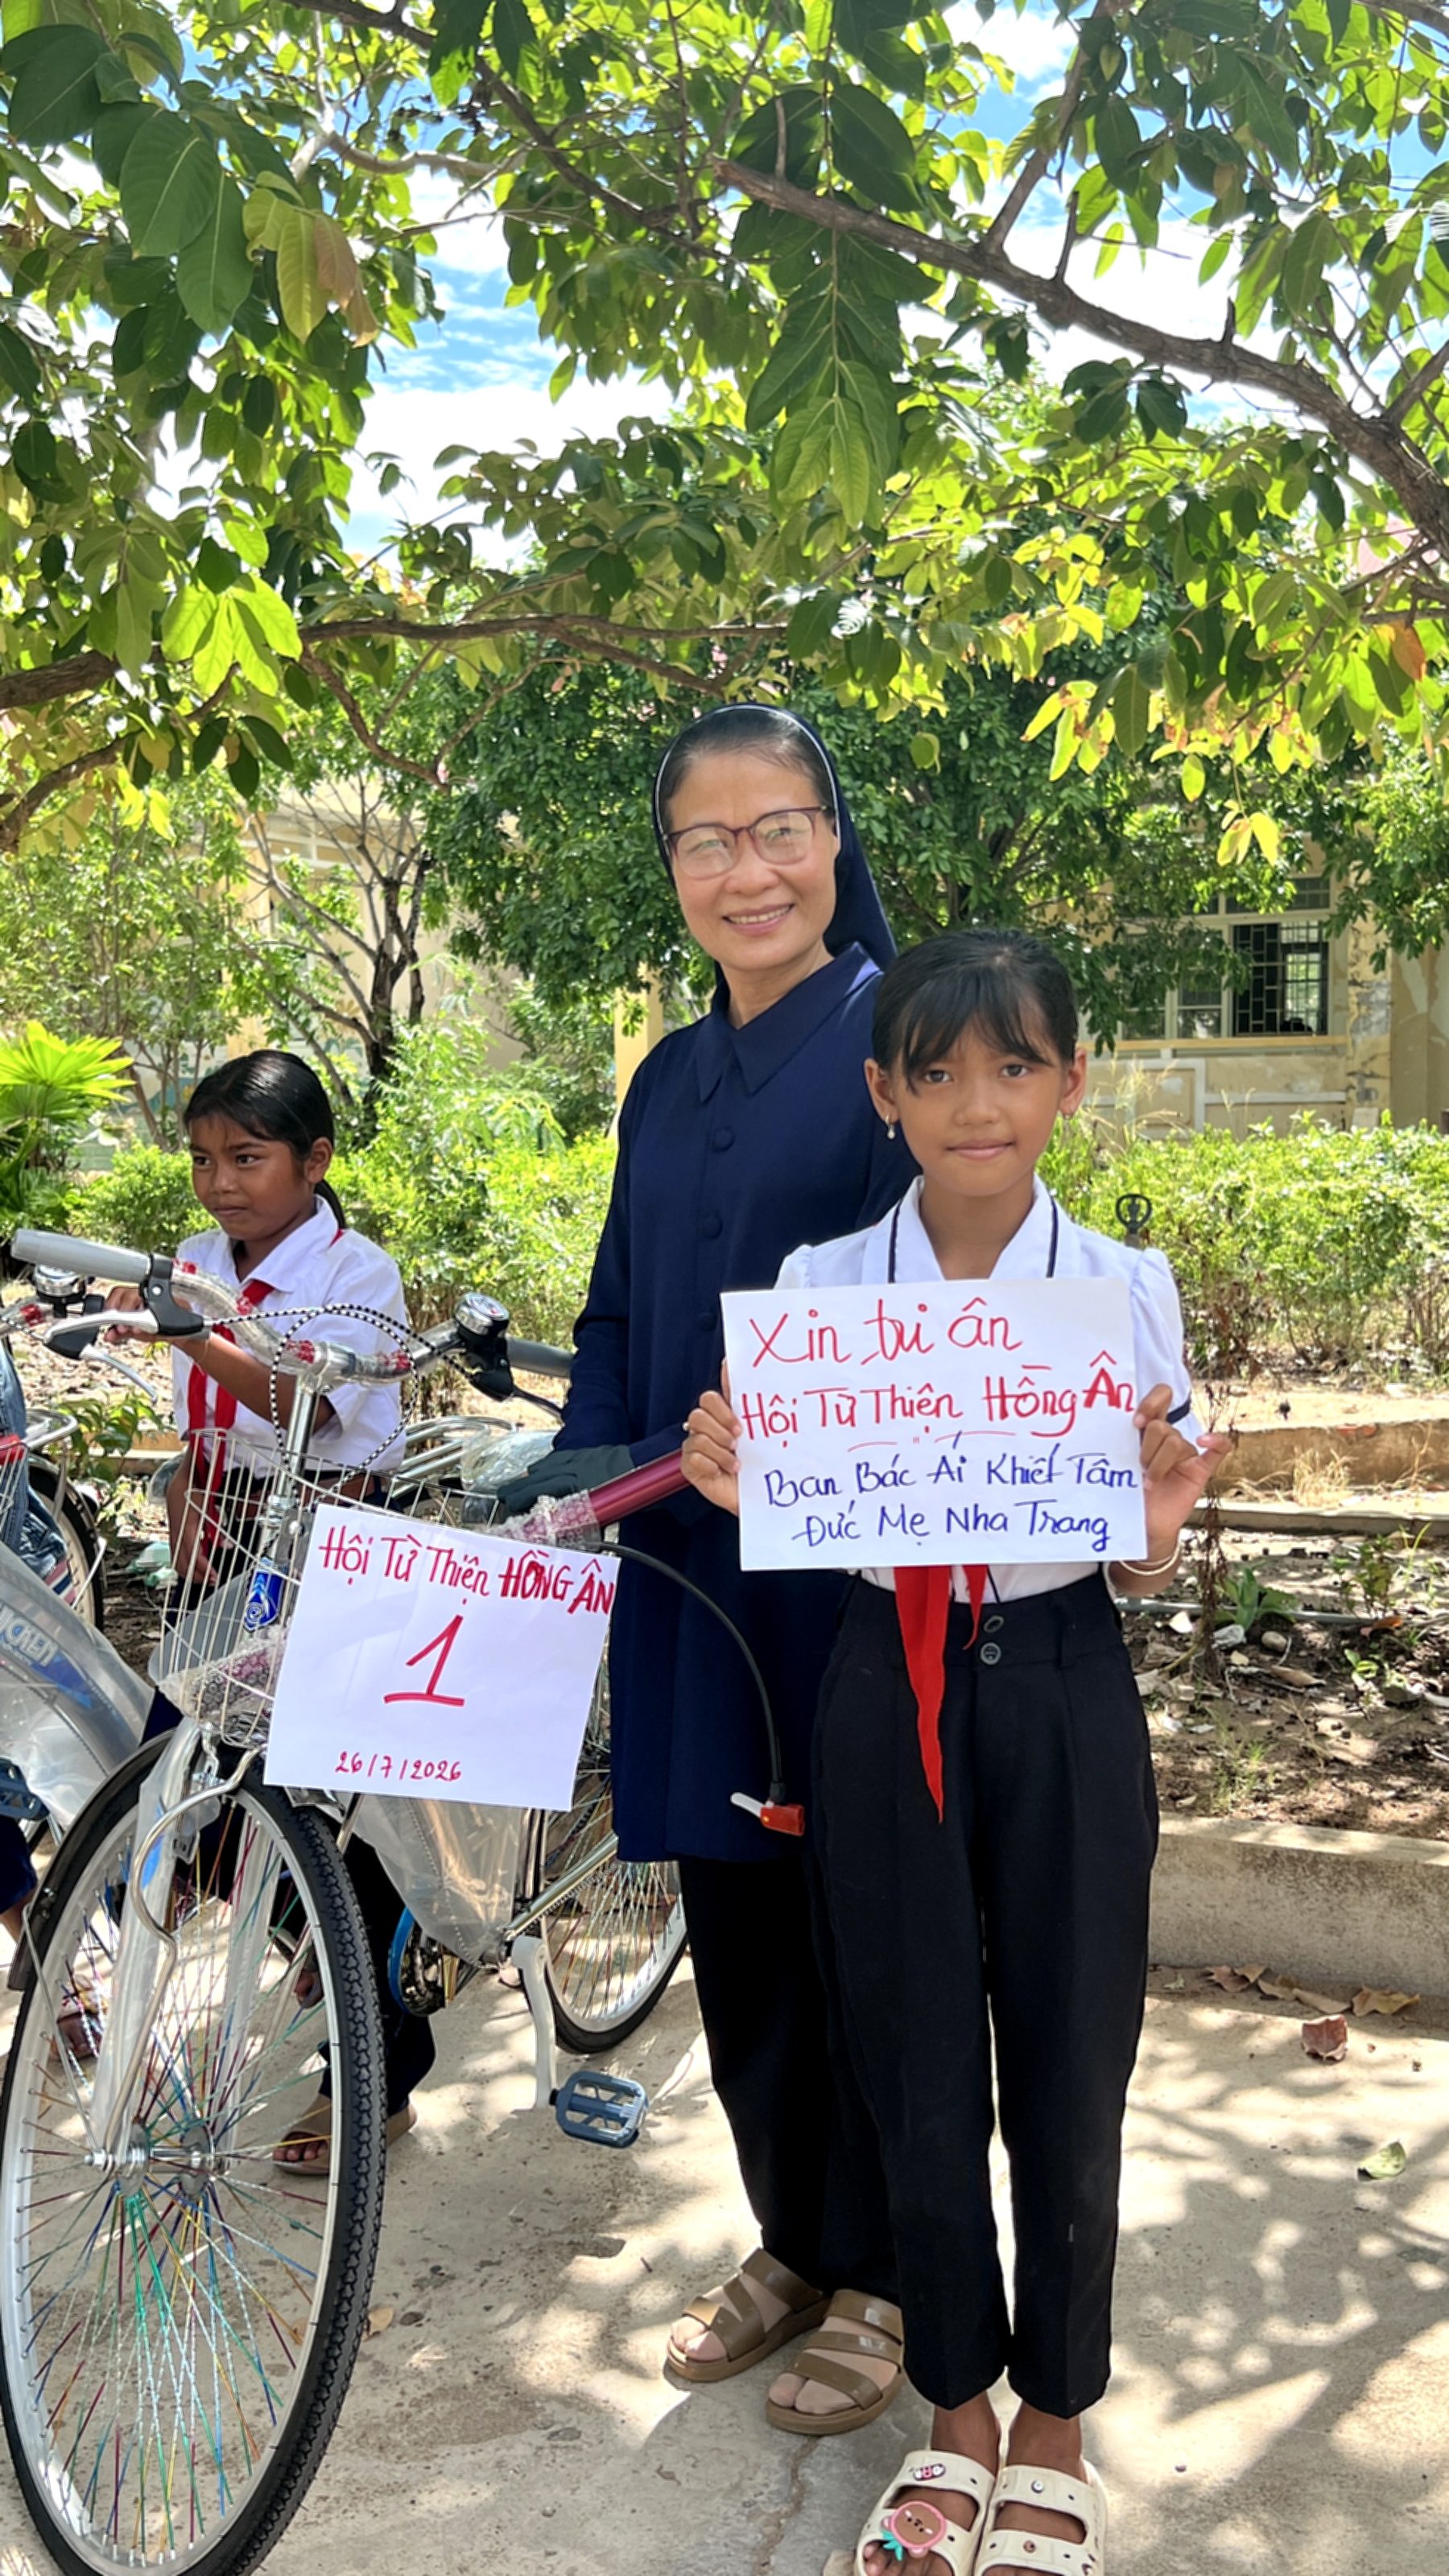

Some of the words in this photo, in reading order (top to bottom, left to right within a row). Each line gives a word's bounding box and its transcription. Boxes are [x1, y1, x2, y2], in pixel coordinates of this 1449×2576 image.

[749, 1310, 852, 1367] Xin
[947, 1296, 1022, 1351] ân
[741, 1392, 799, 1448] Hội
[803, 1386, 857, 1428] Từ
[859, 1381, 964, 1434] Thiện
[982, 1364, 1077, 1438] Hồng
[1082, 1350, 1134, 1413] Ân
[764, 1471, 842, 1507] Ban
[855, 1453, 918, 1494] Bác
[986, 1443, 1064, 1485] Khiết
[1065, 1452, 1139, 1488] Tâm
[791, 1500, 861, 1547] Đức
[877, 1503, 931, 1546] Mẹ
[946, 1503, 1009, 1534] Nha
[1013, 1499, 1111, 1553] Trang
[318, 1525, 374, 1585] Hội
[380, 1533, 423, 1583] Từ
[425, 1544, 491, 1605] Thiện
[497, 1548, 584, 1602] HỒNG
[567, 1558, 617, 1615] ÂN
[382, 1613, 466, 1708] 1
[334, 1750, 464, 1782] 26/7/2026
